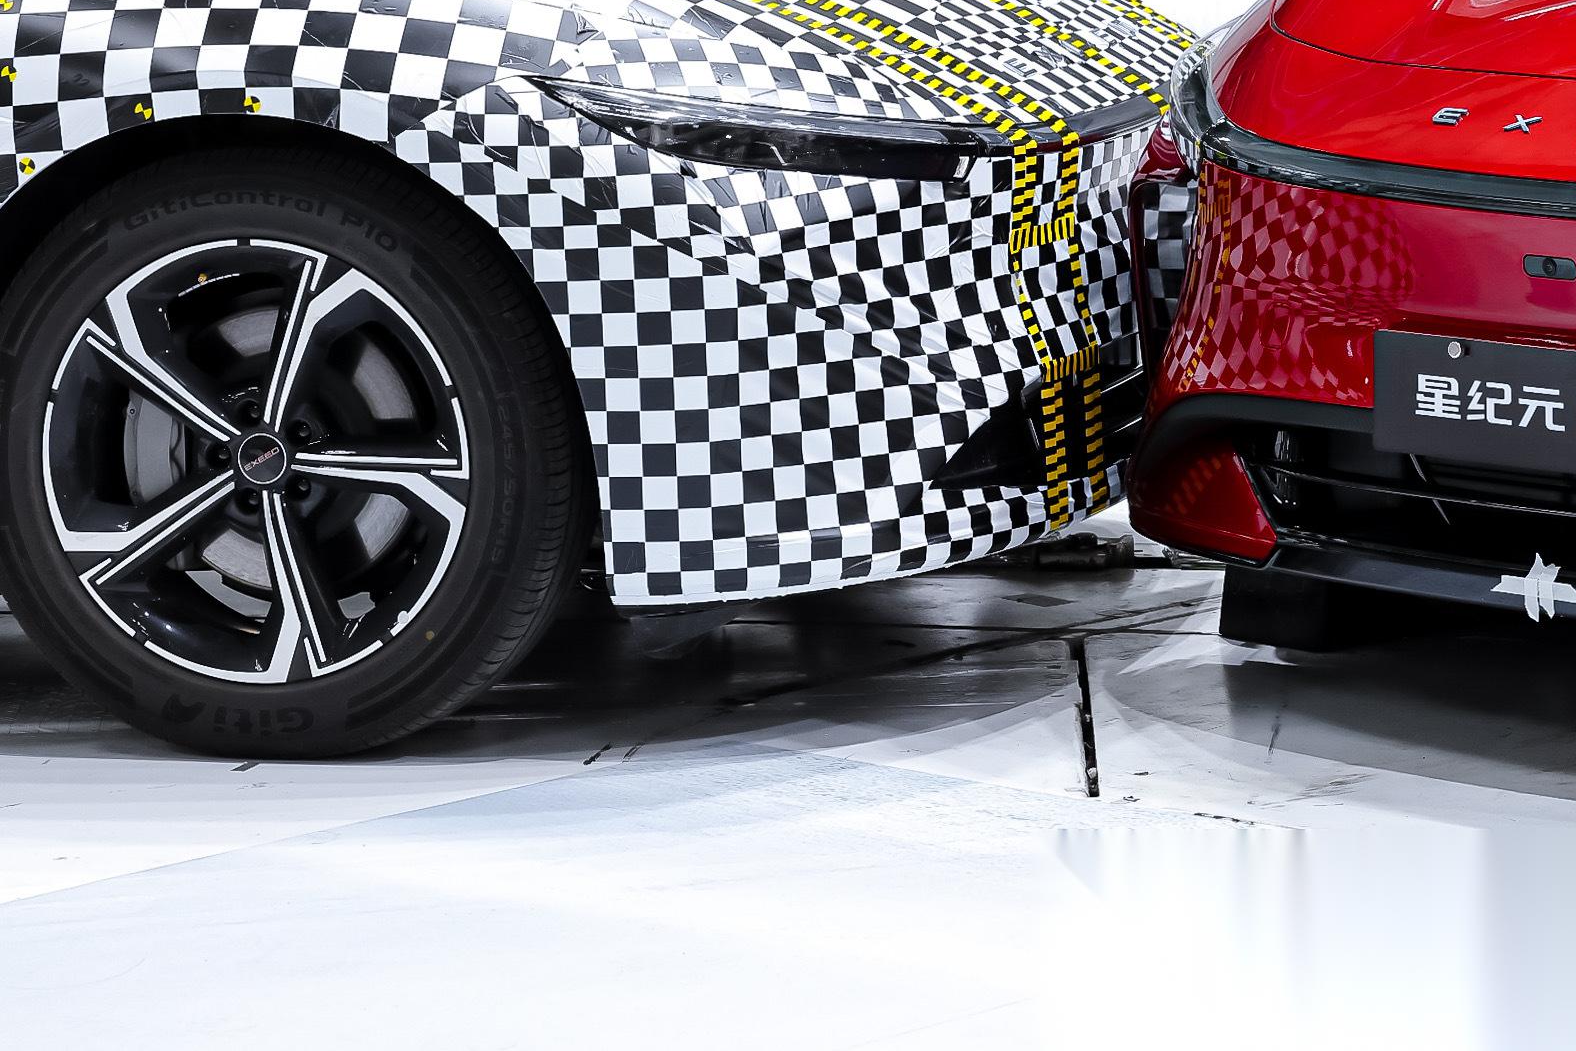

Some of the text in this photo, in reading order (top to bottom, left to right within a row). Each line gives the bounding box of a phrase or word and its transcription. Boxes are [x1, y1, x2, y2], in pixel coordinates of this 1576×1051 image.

[123, 189, 399, 253] GitiControl P10
[1415, 373, 1566, 433] 星纪元
[244, 446, 280, 472] EXEED
